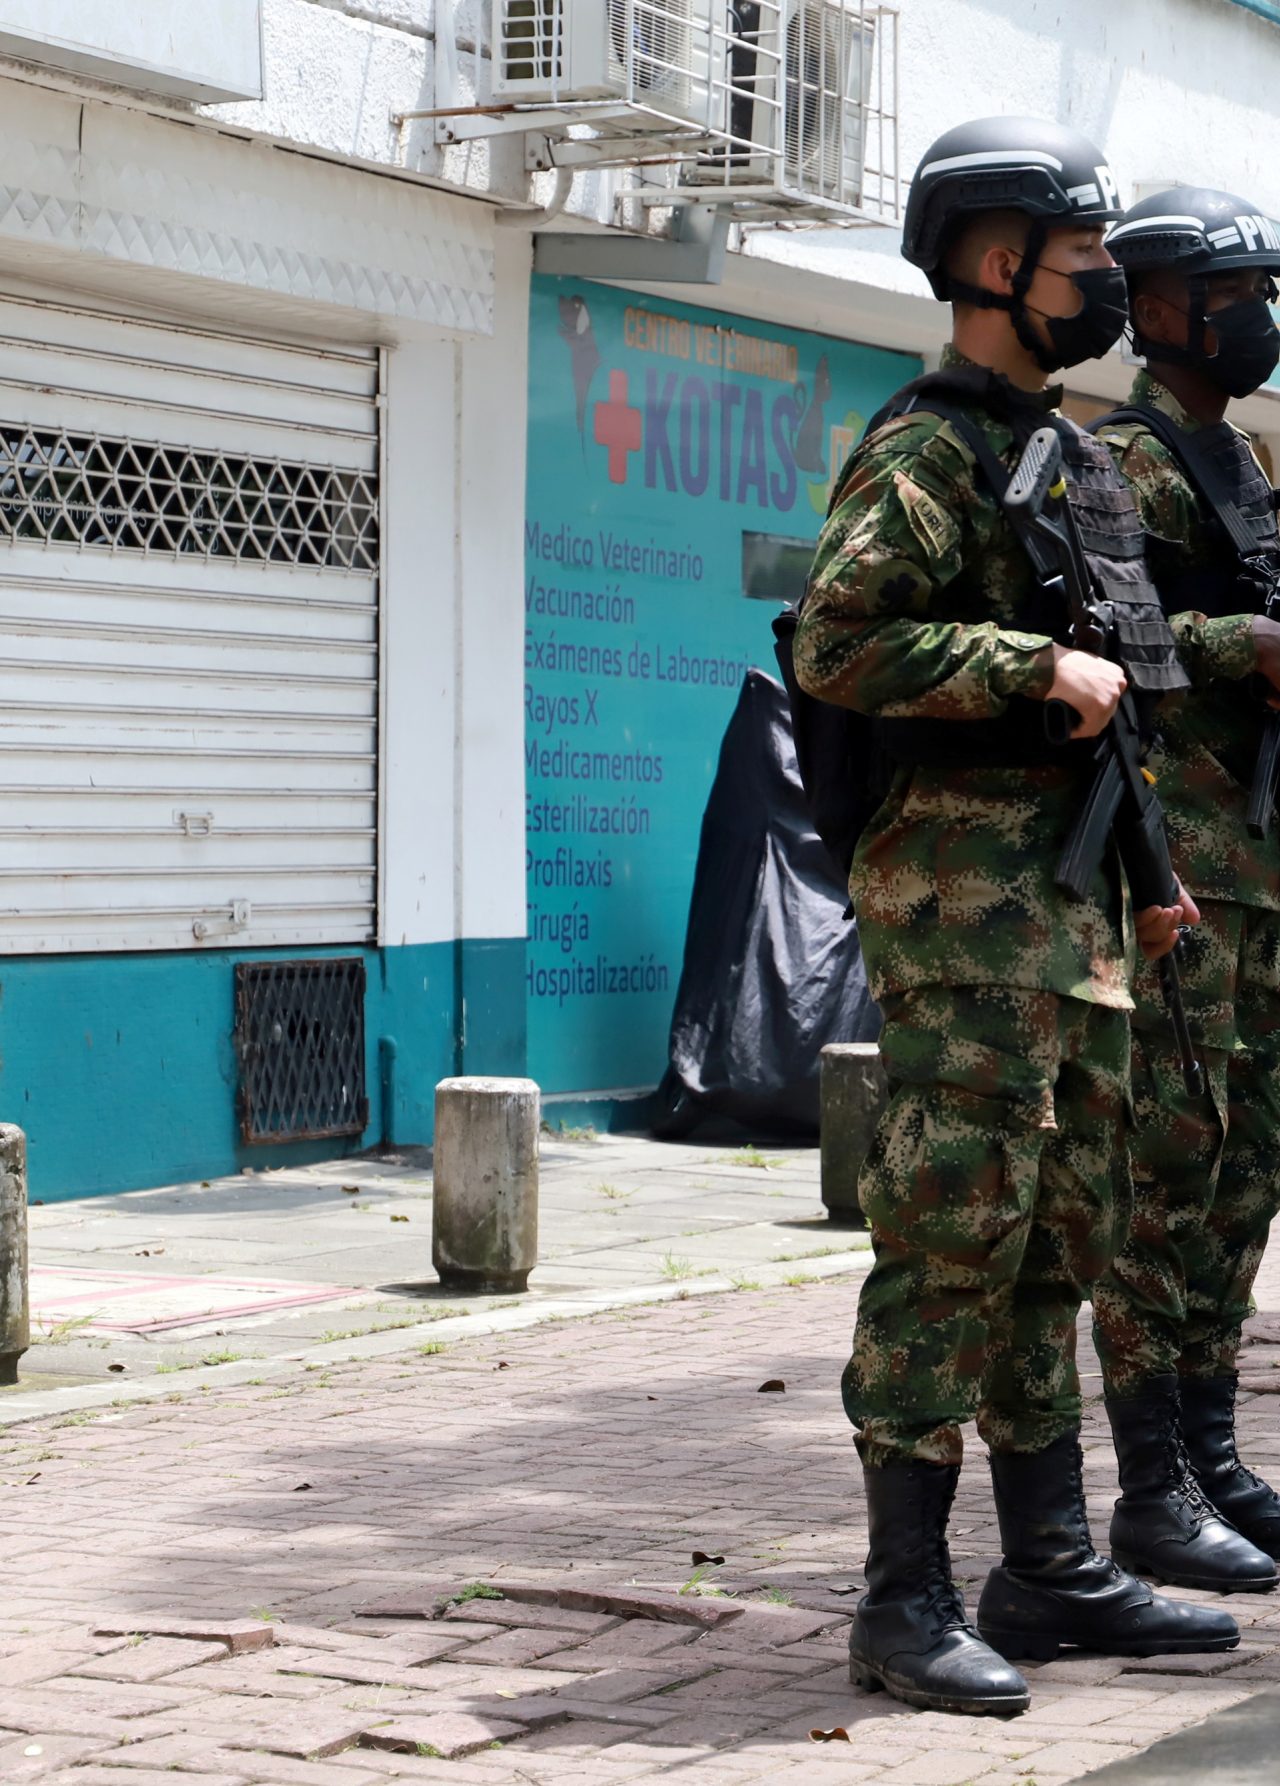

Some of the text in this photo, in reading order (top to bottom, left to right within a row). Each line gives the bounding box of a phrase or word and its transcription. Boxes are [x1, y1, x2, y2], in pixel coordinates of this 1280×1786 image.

[624, 304, 798, 384] CENTRO VETERINARIO
[644, 367, 798, 512] KOTAS
[525, 519, 703, 581] Medico Veterinario
[525, 576, 635, 624] Vacunación
[525, 629, 757, 688] Exámenes de Laboratori
[525, 683, 598, 735] Rayos X
[525, 738, 663, 783] Medicamentos
